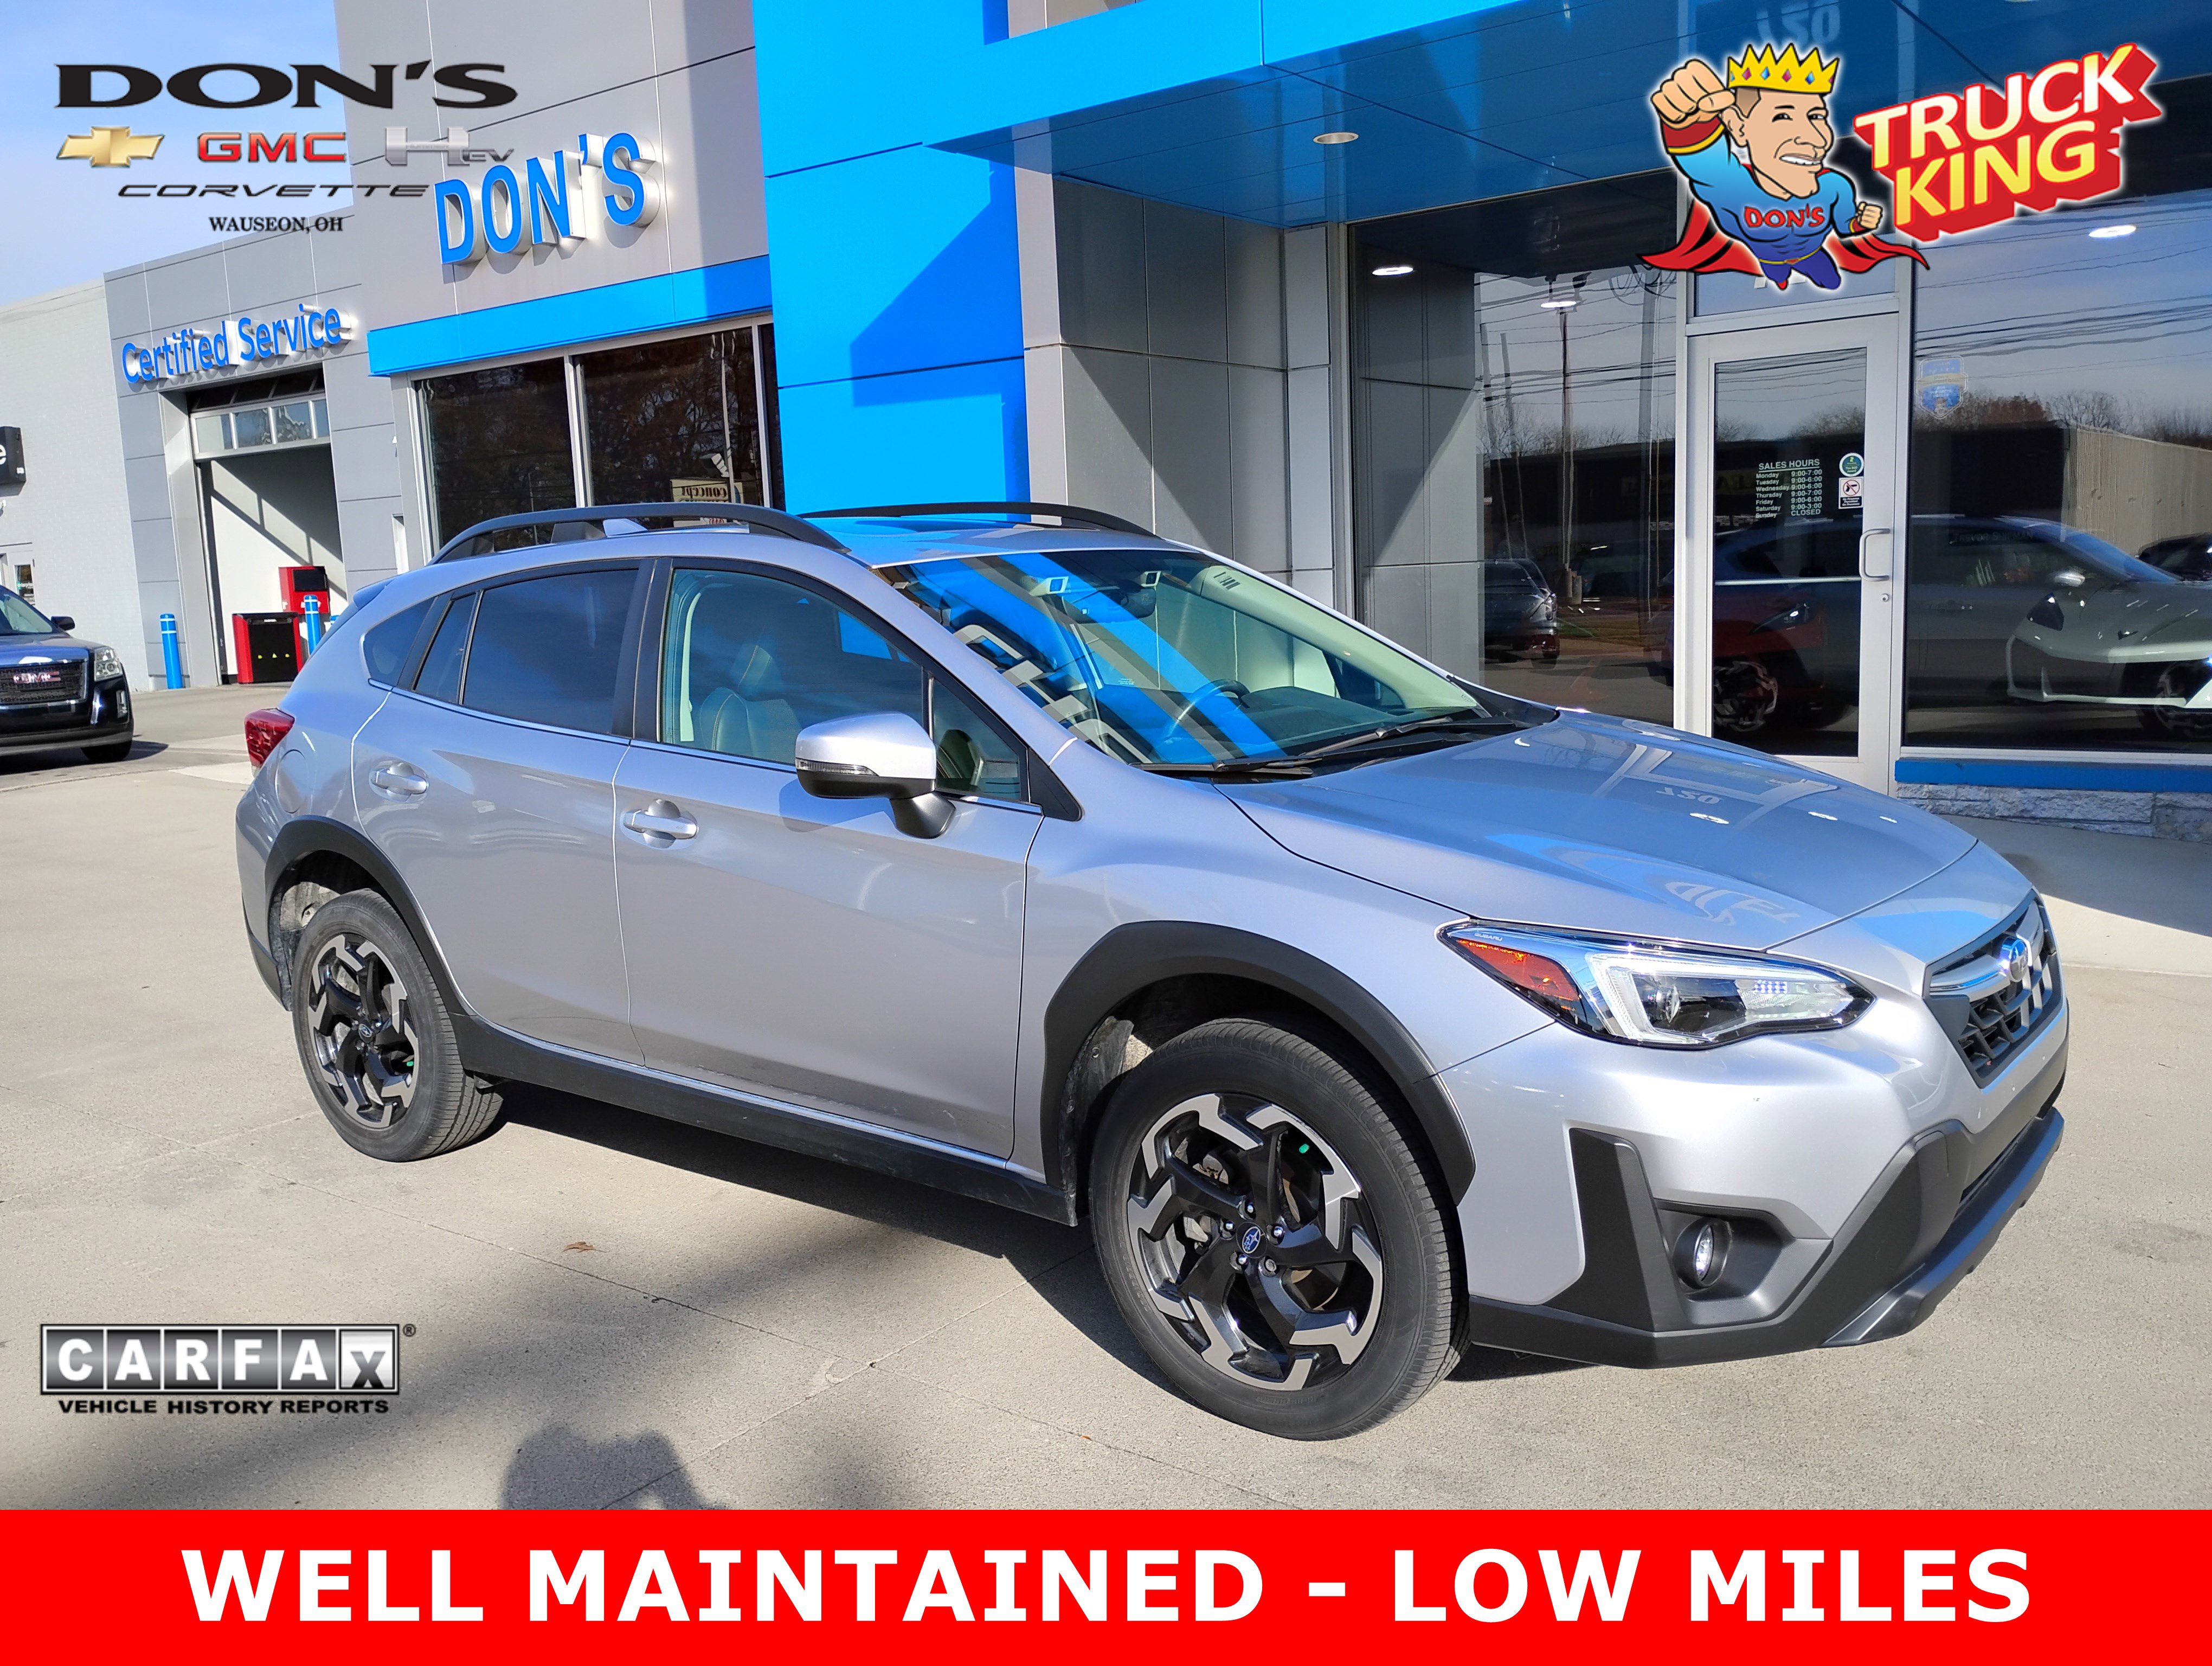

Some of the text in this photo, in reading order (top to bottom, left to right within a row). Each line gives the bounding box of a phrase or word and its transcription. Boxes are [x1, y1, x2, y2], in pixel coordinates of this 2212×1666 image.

[434, 132, 647, 265] DON'S
[121, 303, 343, 383] Certified Service
[1758, 458, 1820, 470] SALES HOURS
[1475, 933, 1503, 941] SUBARU
